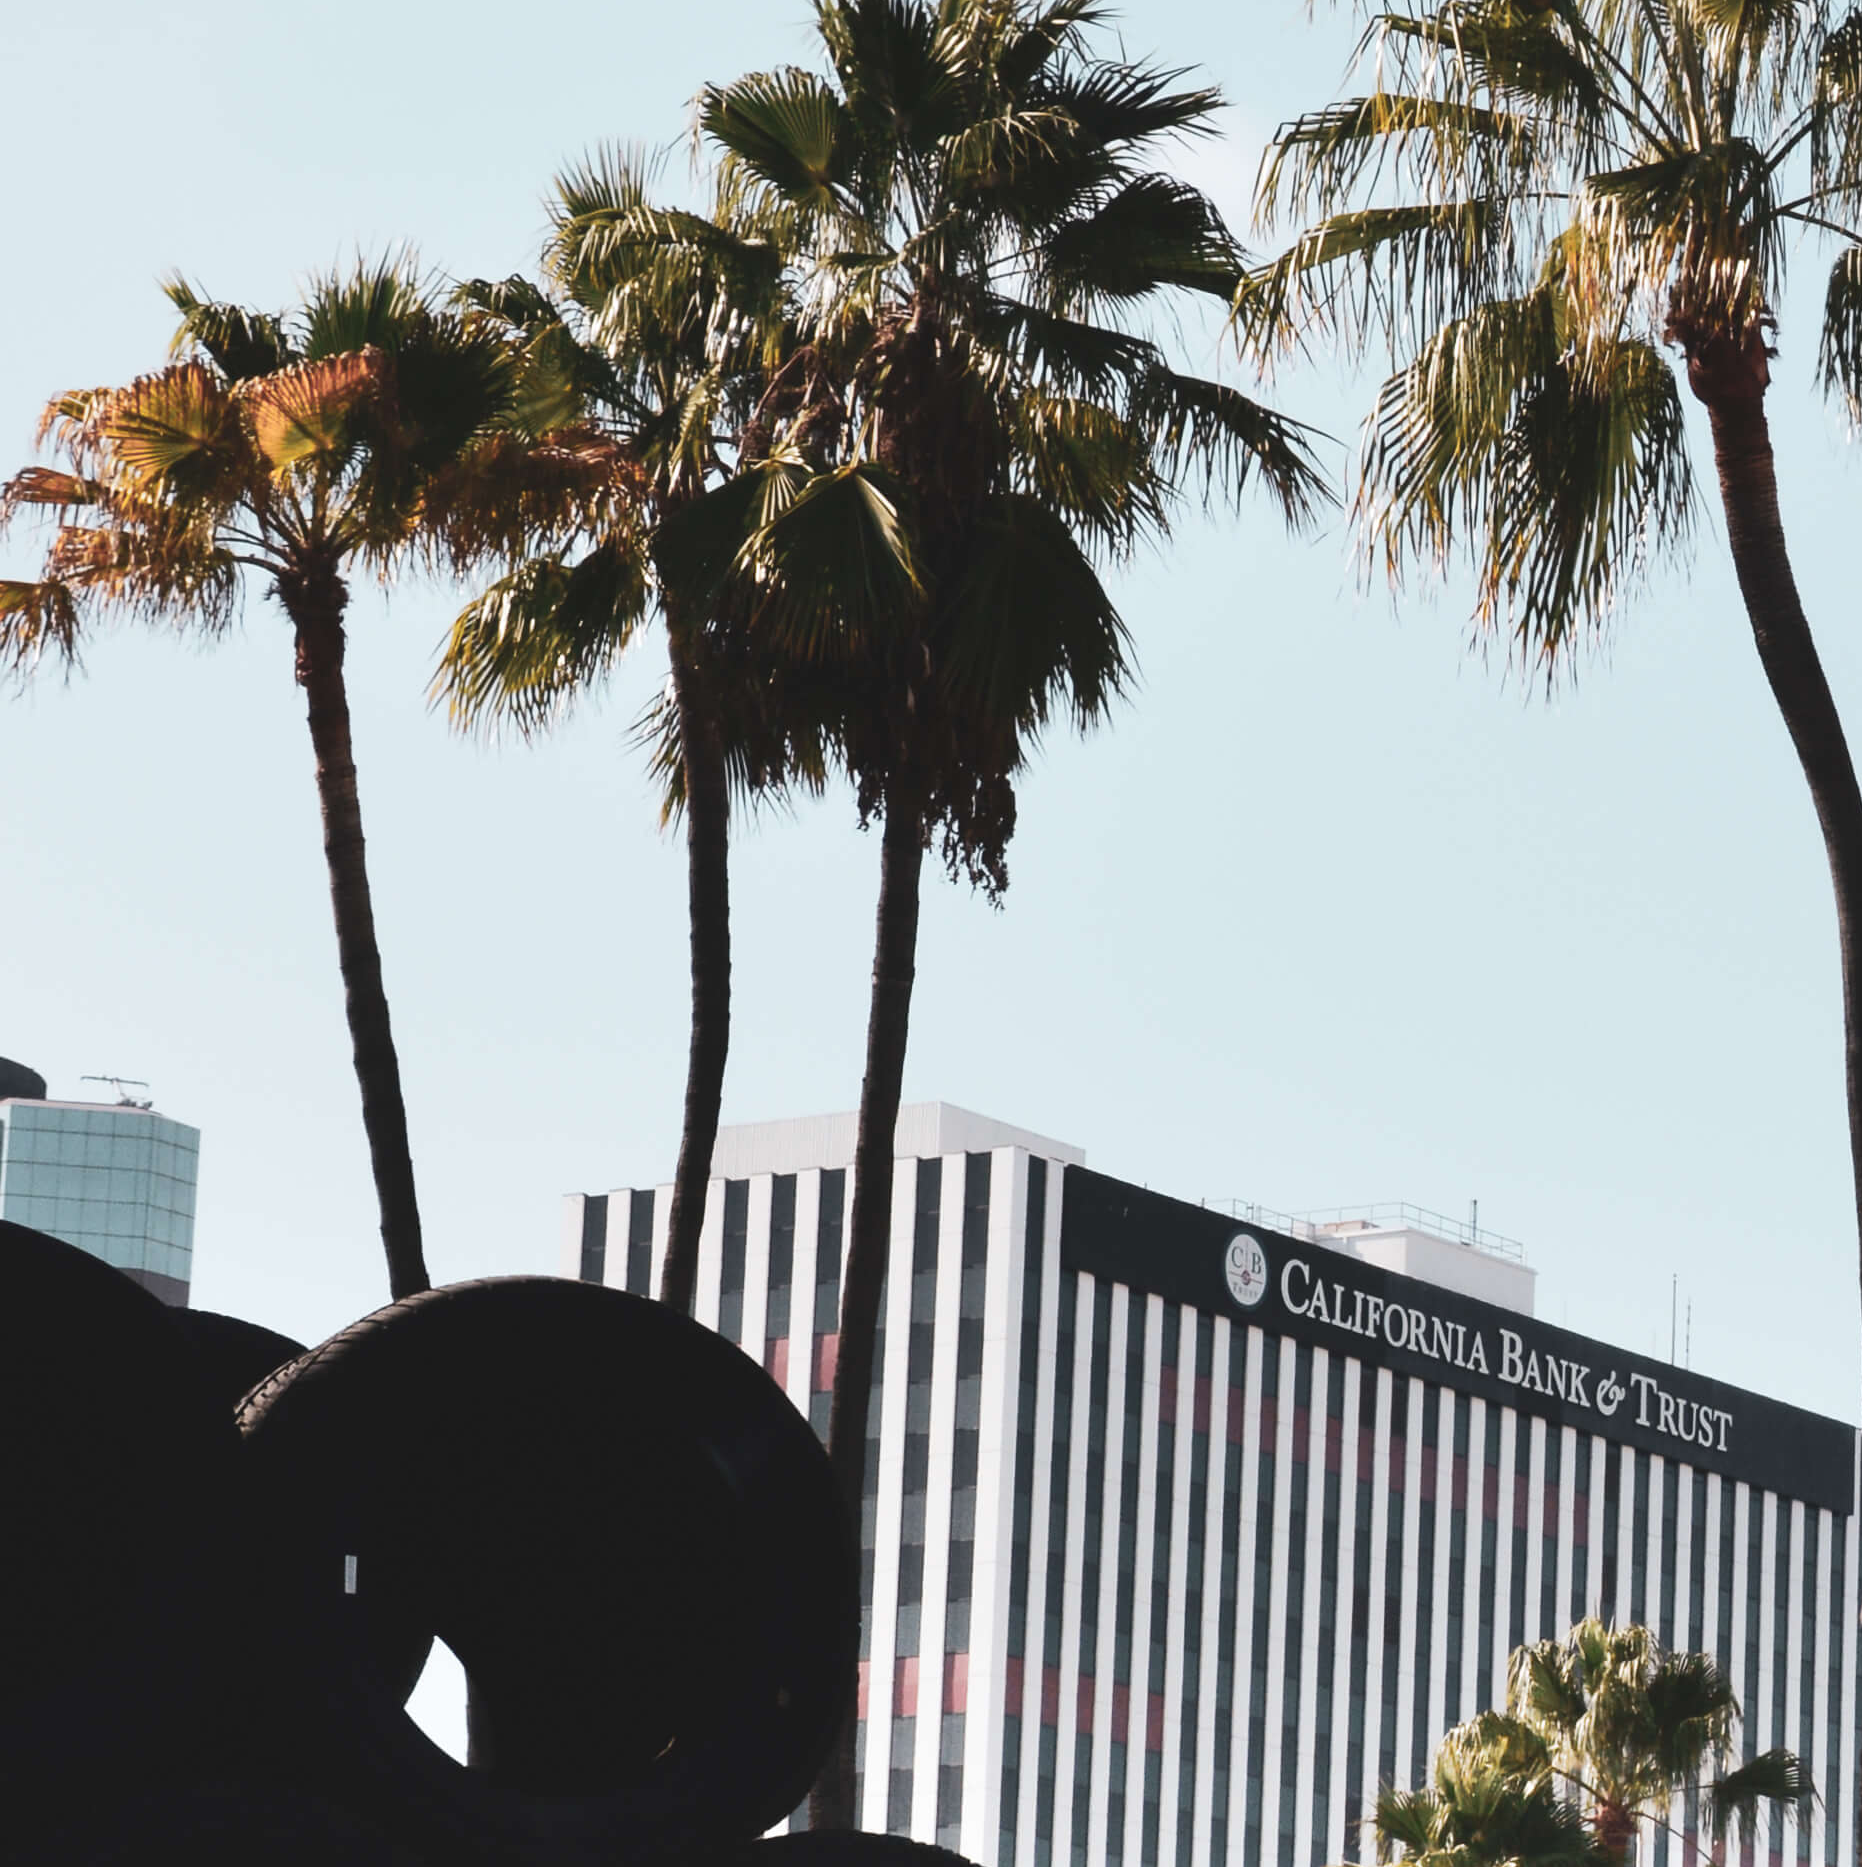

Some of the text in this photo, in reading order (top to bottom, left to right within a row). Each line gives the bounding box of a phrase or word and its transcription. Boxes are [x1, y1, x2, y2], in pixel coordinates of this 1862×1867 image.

[1281, 1259, 1733, 1452] CALIFORNIA BANK & TRUST
